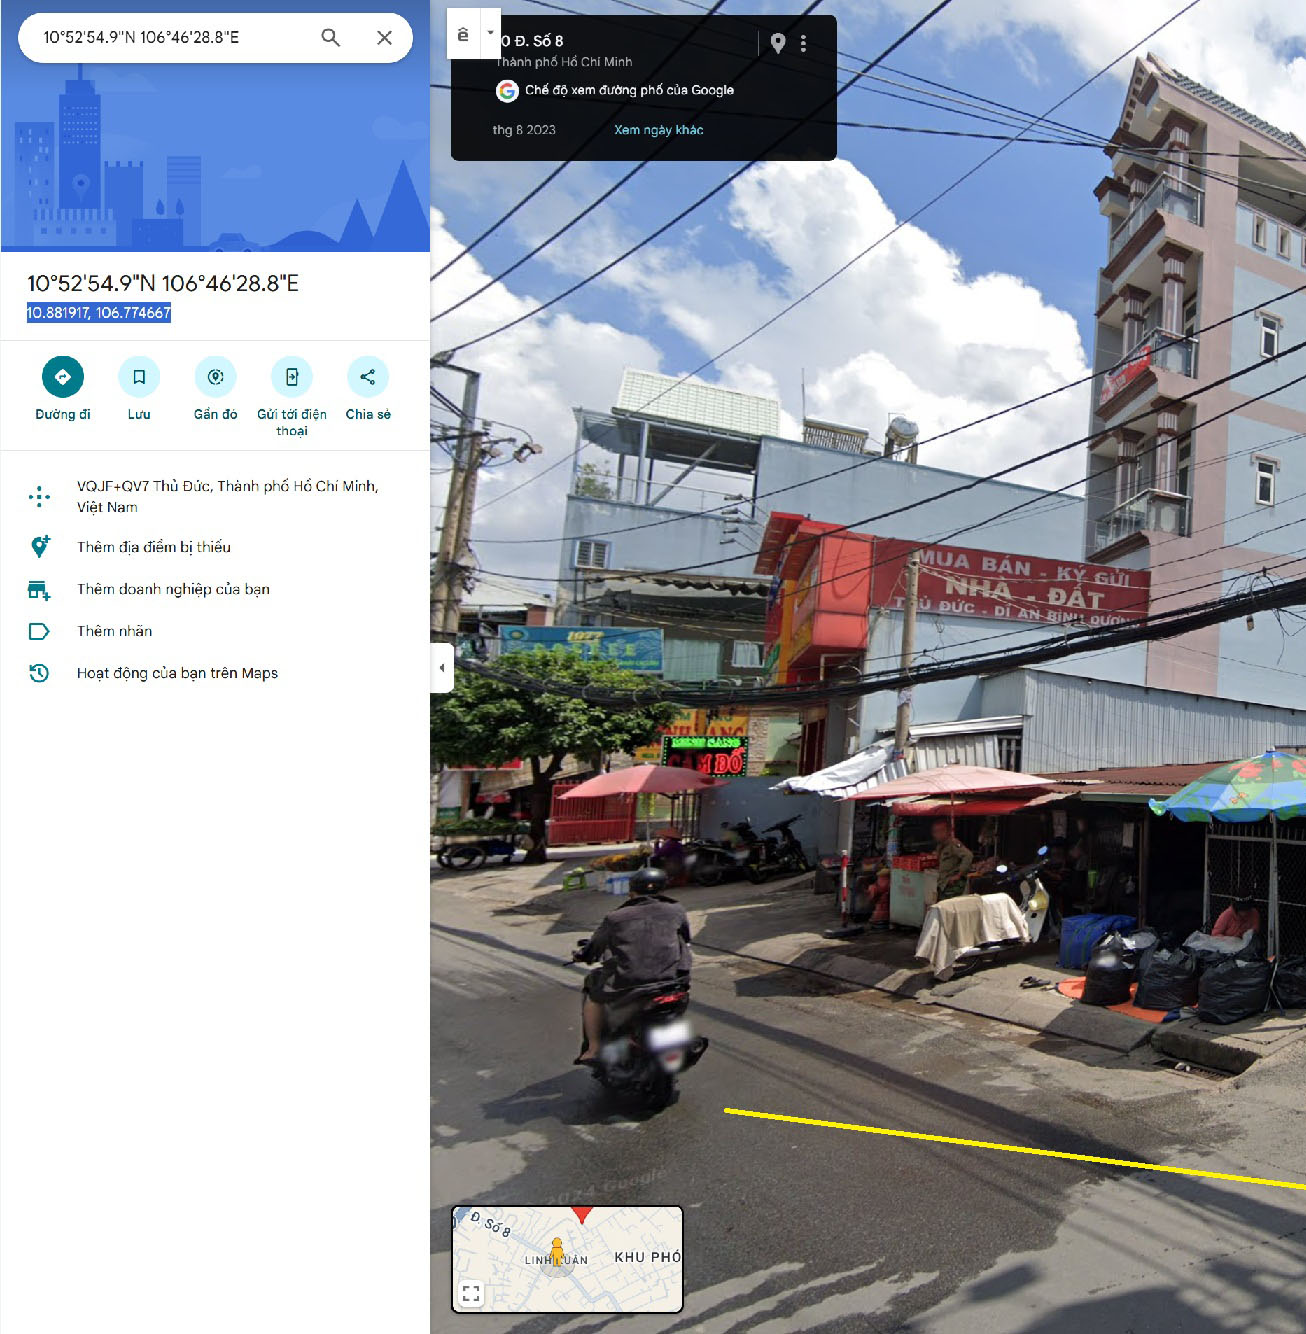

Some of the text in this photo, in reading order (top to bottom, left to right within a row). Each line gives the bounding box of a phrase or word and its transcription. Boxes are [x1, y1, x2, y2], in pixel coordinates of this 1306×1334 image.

[919, 549, 969, 569] MUA
[982, 554, 1031, 577] BÁN
[1057, 564, 1087, 582] KÝ
[1094, 570, 1130, 588] GỬI
[893, 595, 931, 611] TỦ
[938, 598, 976, 614] ĐỨC
[1017, 608, 1041, 621] AN
[945, 575, 1011, 599] NHÀ
[1048, 584, 1105, 611] ĐẤT
